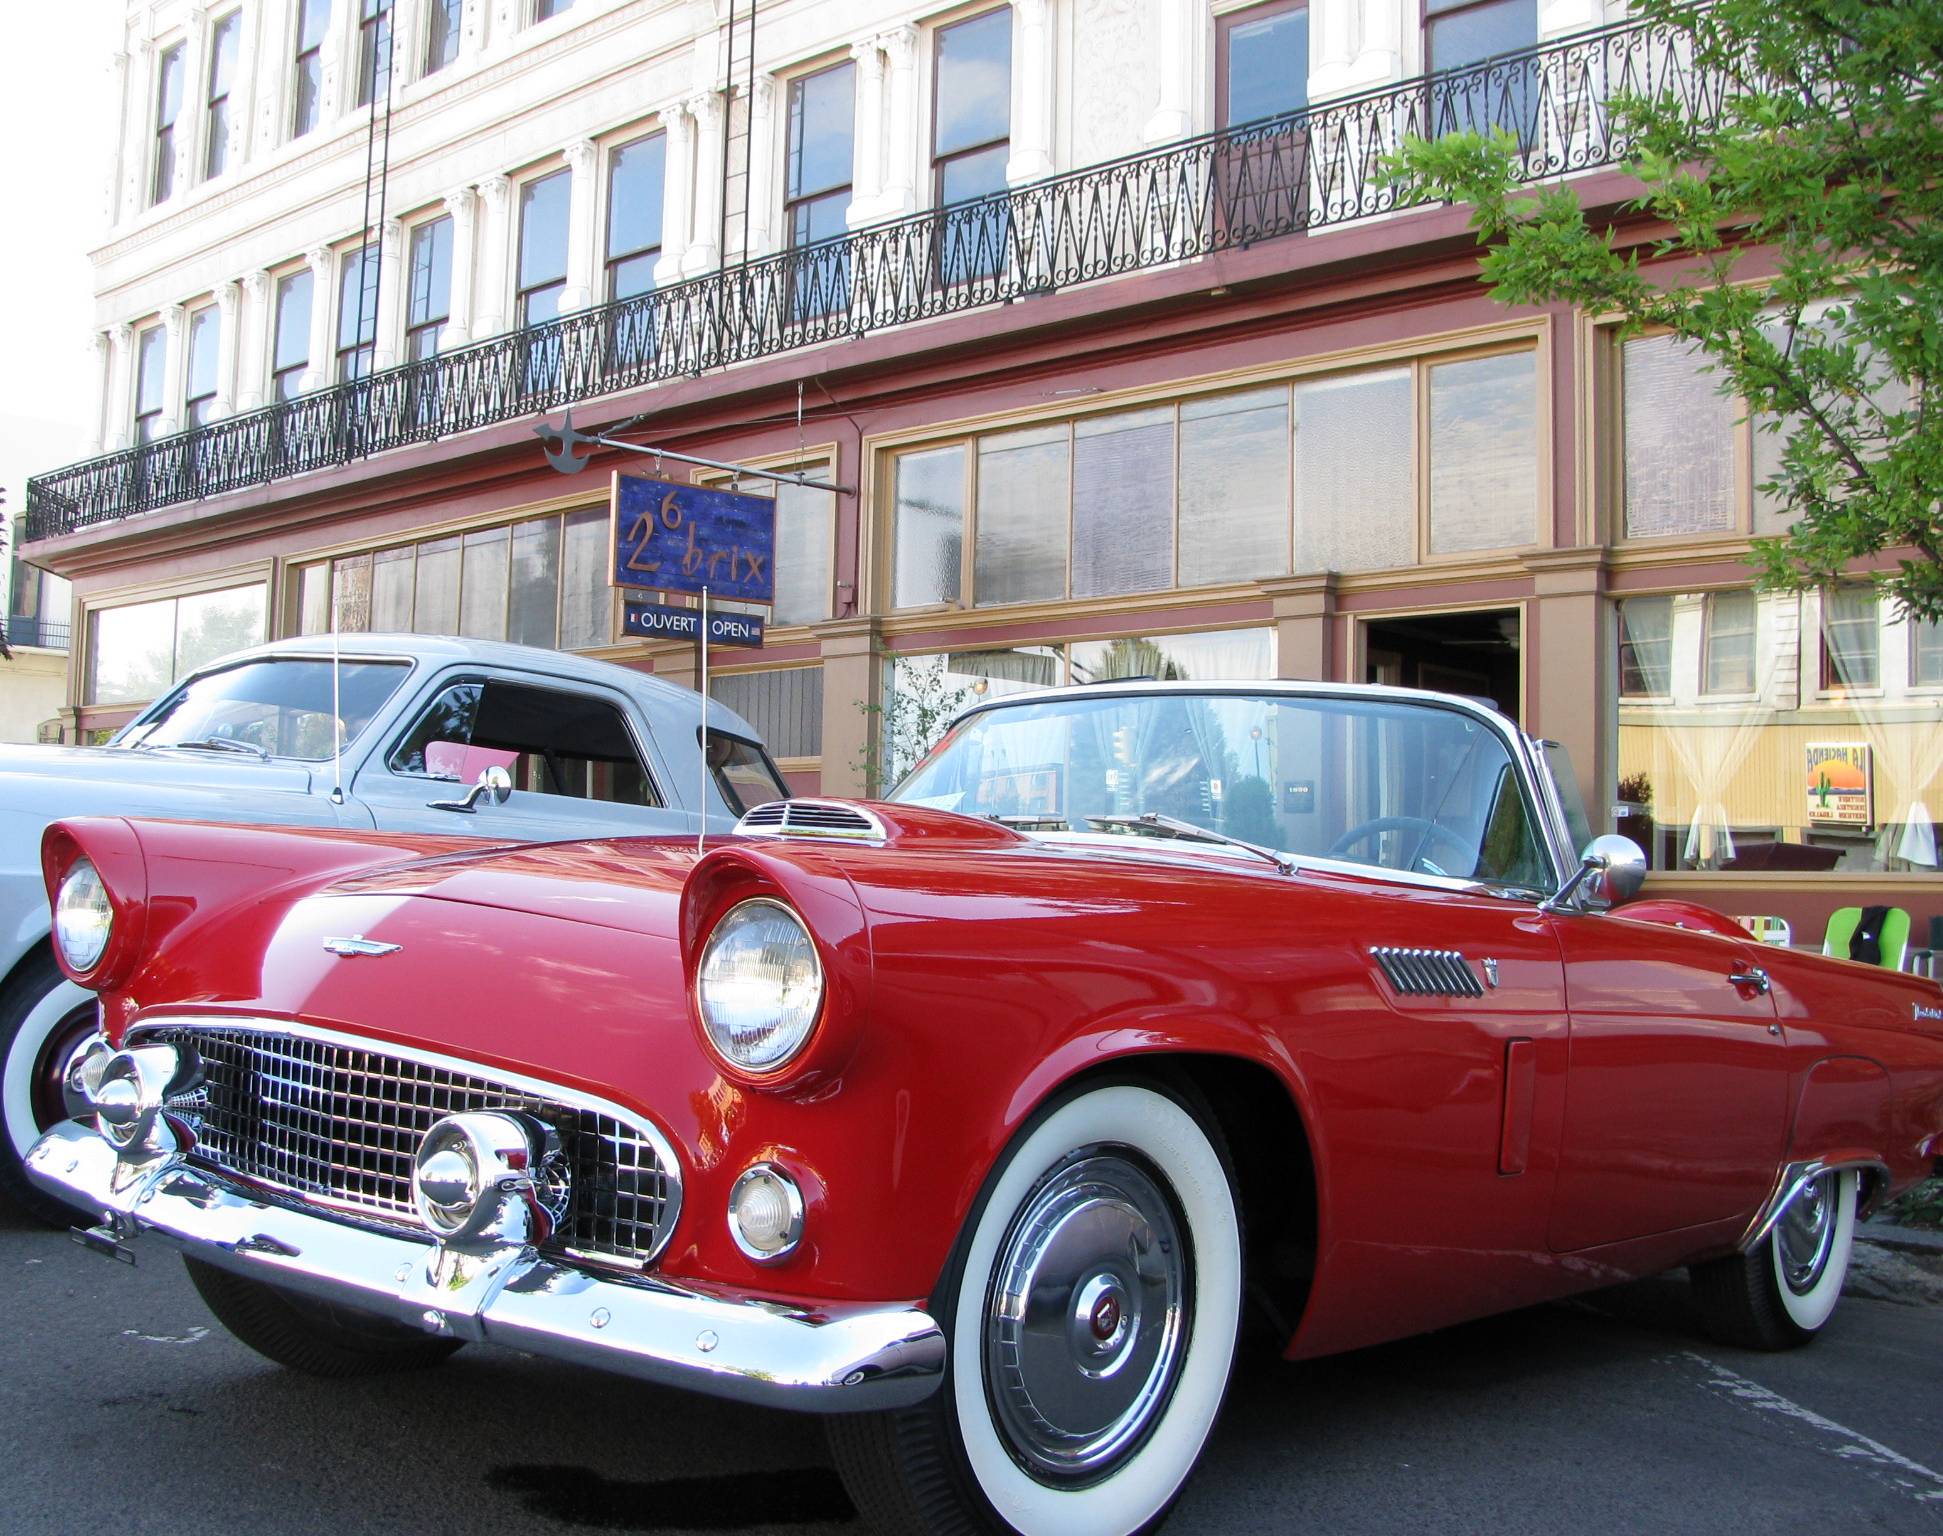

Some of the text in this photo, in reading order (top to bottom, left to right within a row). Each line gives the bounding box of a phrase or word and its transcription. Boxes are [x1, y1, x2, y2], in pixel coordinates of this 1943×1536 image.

[682, 520, 764, 583] brix
[641, 612, 749, 638] OUVERT OPEN
